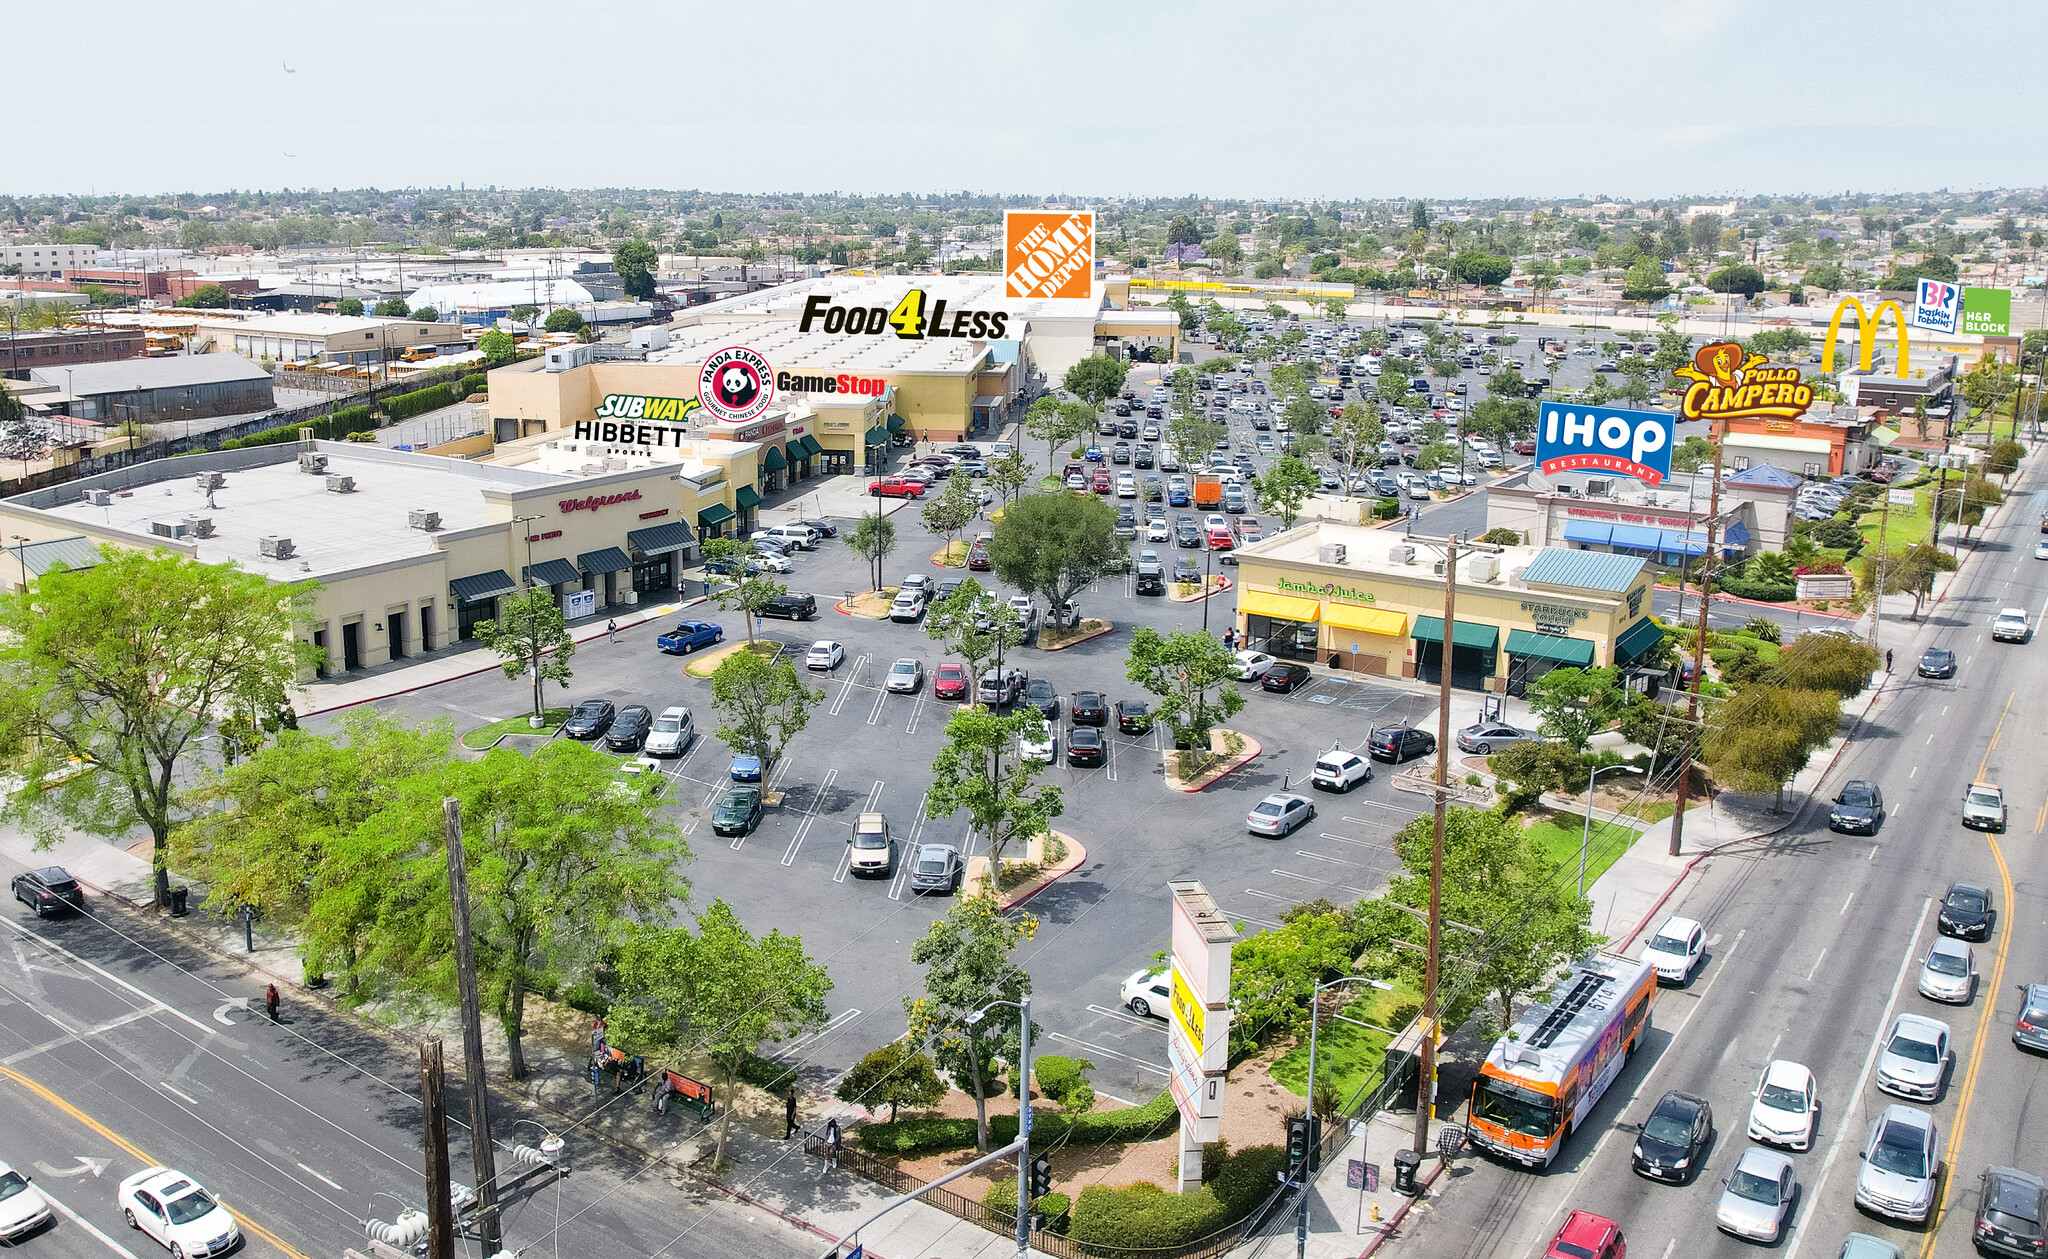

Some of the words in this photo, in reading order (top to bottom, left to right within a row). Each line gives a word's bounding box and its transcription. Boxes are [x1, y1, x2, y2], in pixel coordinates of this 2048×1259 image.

[559, 489, 643, 514] Walgreens
[1277, 577, 1326, 595] Jamba
[1332, 586, 1376, 602] Juice
[1520, 602, 1589, 619] STARBUCKS
[1531, 613, 1575, 626] COFFEE
[1587, 989, 1617, 1011] 5714
